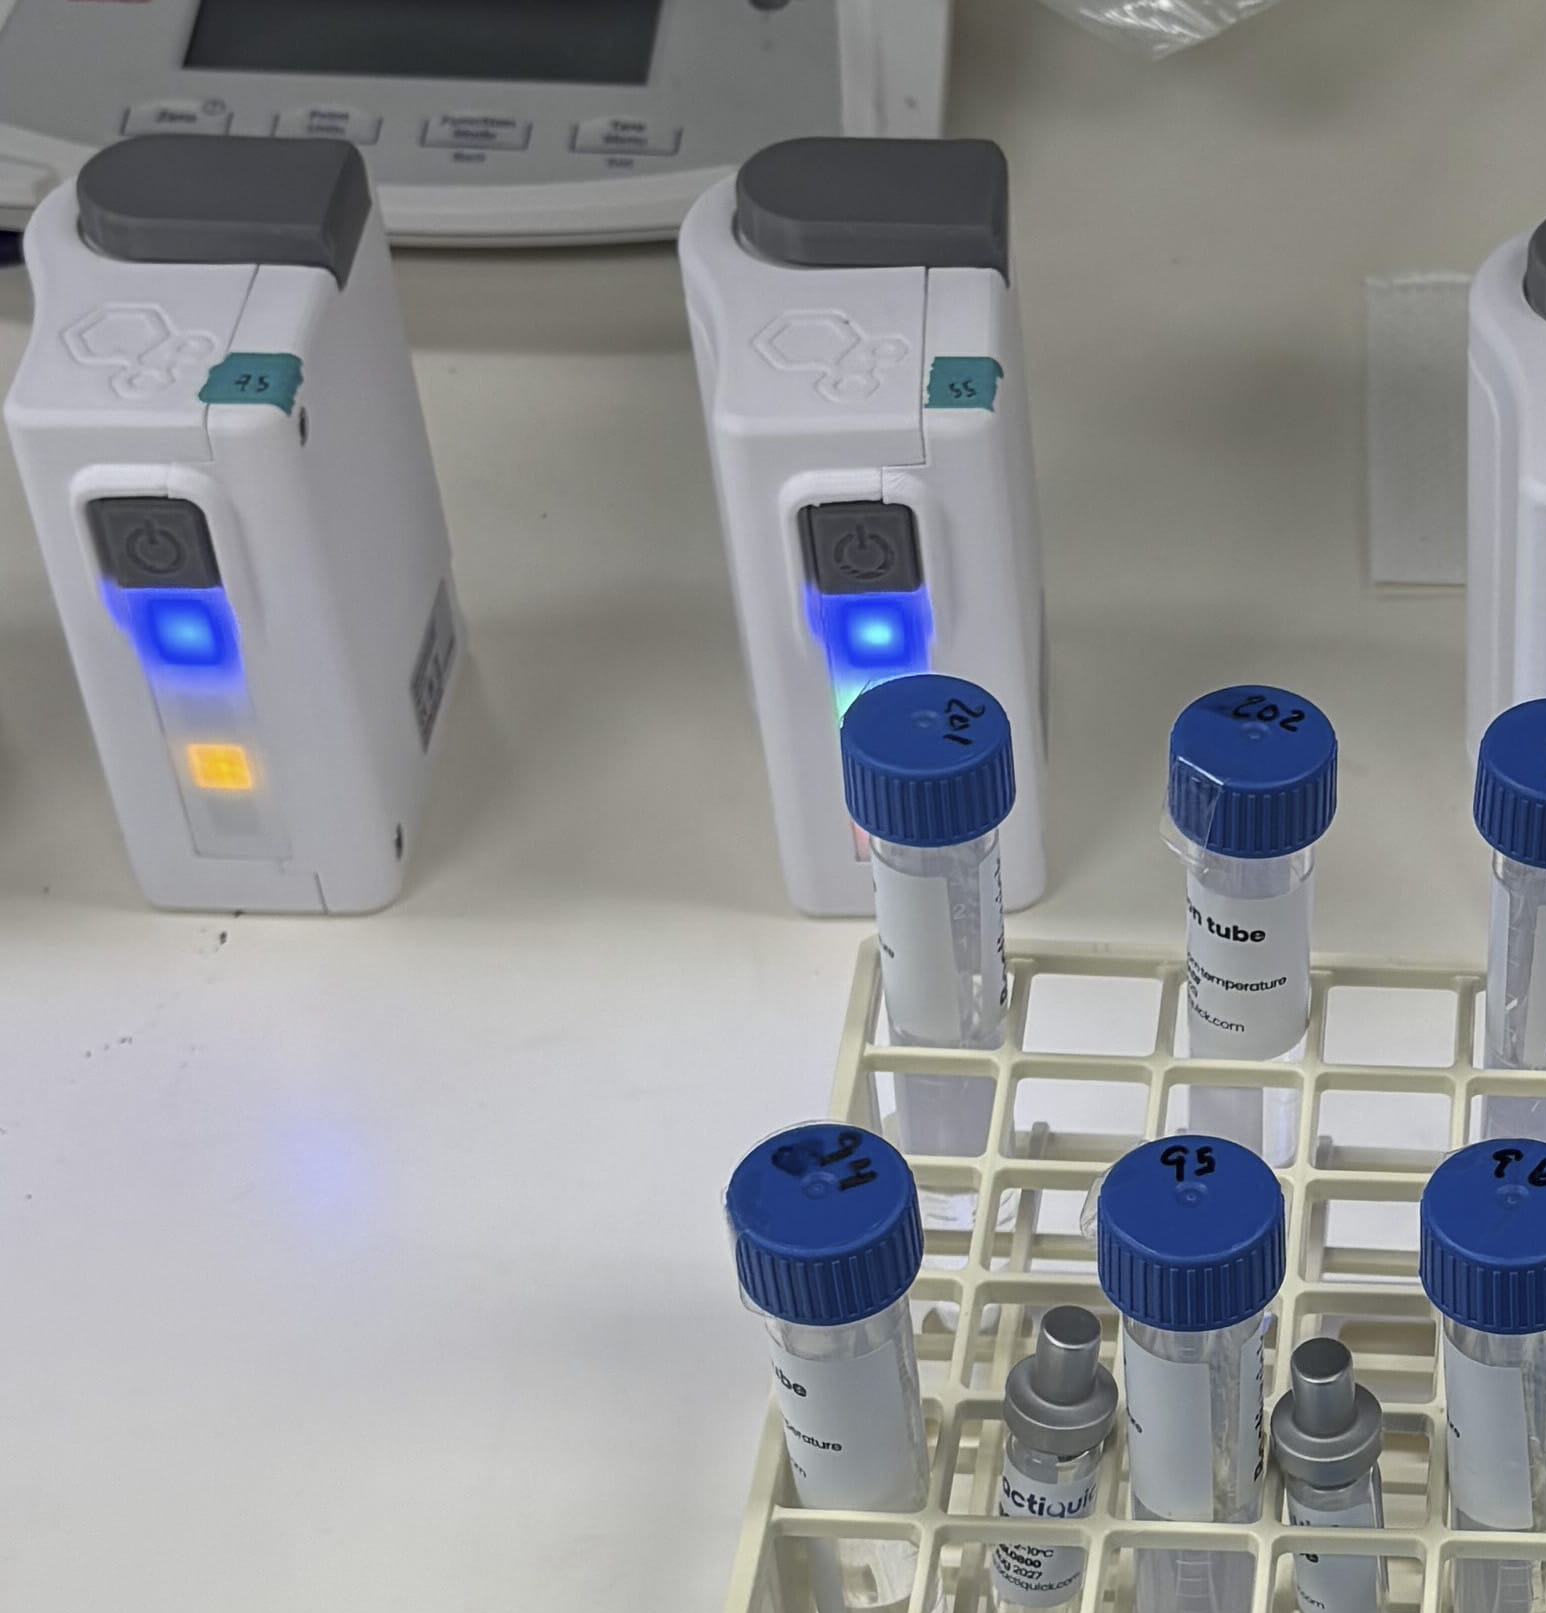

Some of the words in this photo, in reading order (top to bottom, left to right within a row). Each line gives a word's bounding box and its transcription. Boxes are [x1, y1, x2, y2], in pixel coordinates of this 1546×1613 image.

[942, 697, 986, 746] 201
[1232, 694, 1306, 733] 202
[1206, 916, 1267, 943] tube
[1160, 1144, 1217, 1183] 95
